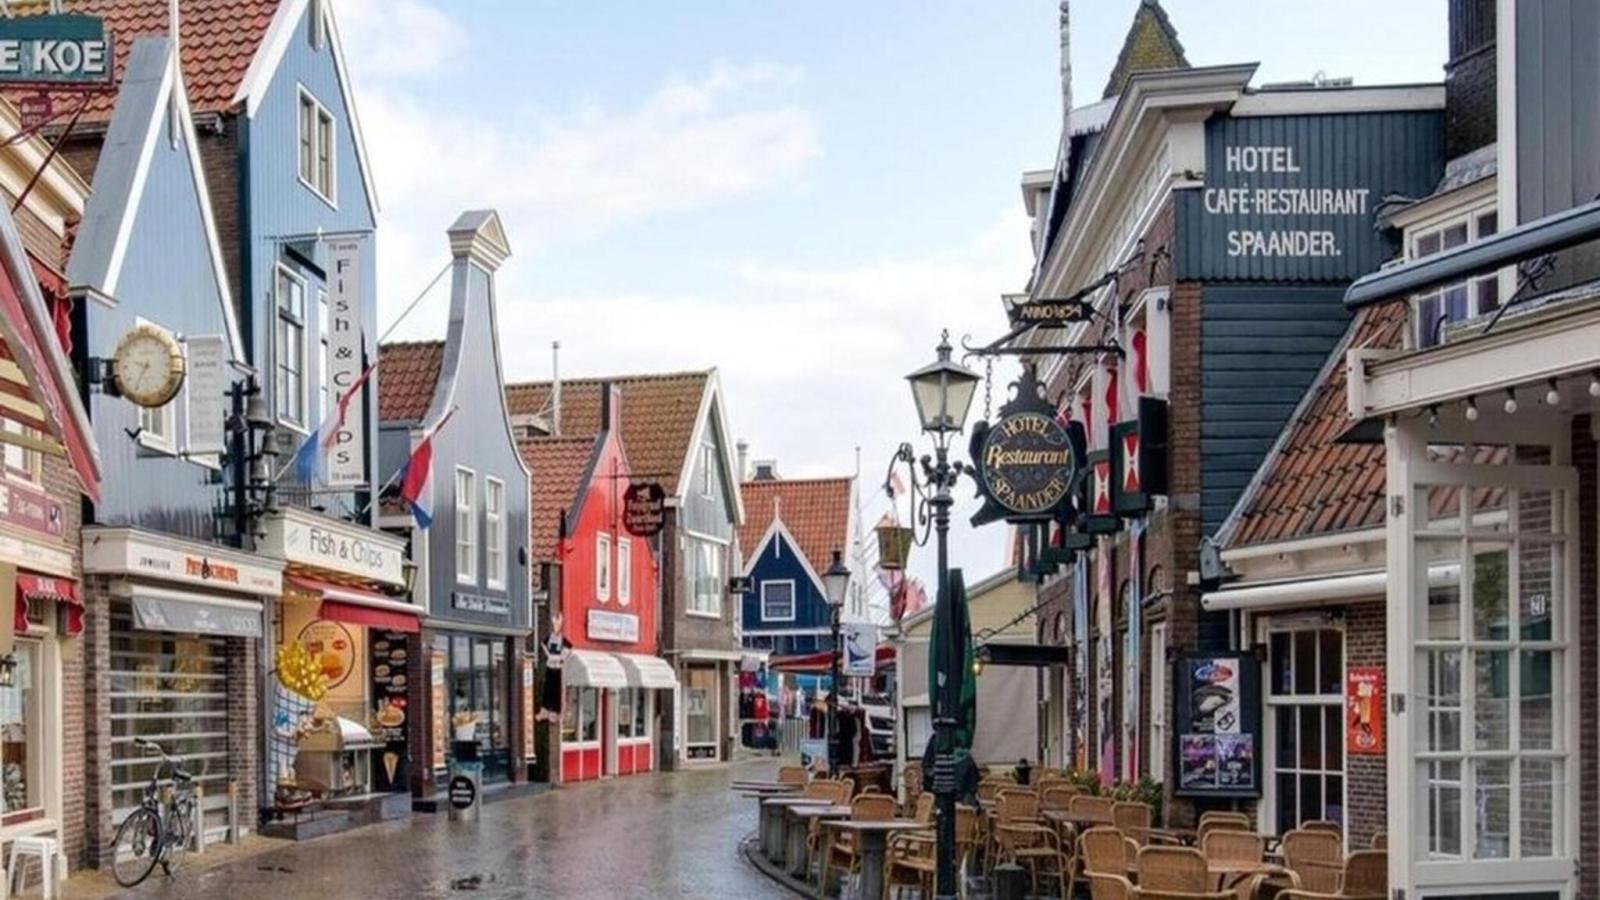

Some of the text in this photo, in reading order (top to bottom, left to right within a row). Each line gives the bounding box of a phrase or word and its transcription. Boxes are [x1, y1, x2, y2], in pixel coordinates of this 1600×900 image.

[0, 39, 104, 73] E KOE
[1226, 146, 1301, 172] HOTEL
[1227, 230, 1341, 257] SPAANDER.
[333, 258, 353, 465] Fish & Cps
[1001, 416, 1050, 438] HOTEL
[986, 443, 1069, 470] Restaurant
[991, 478, 1065, 510] SPAANDER
[309, 527, 384, 569] Fish & Chips
